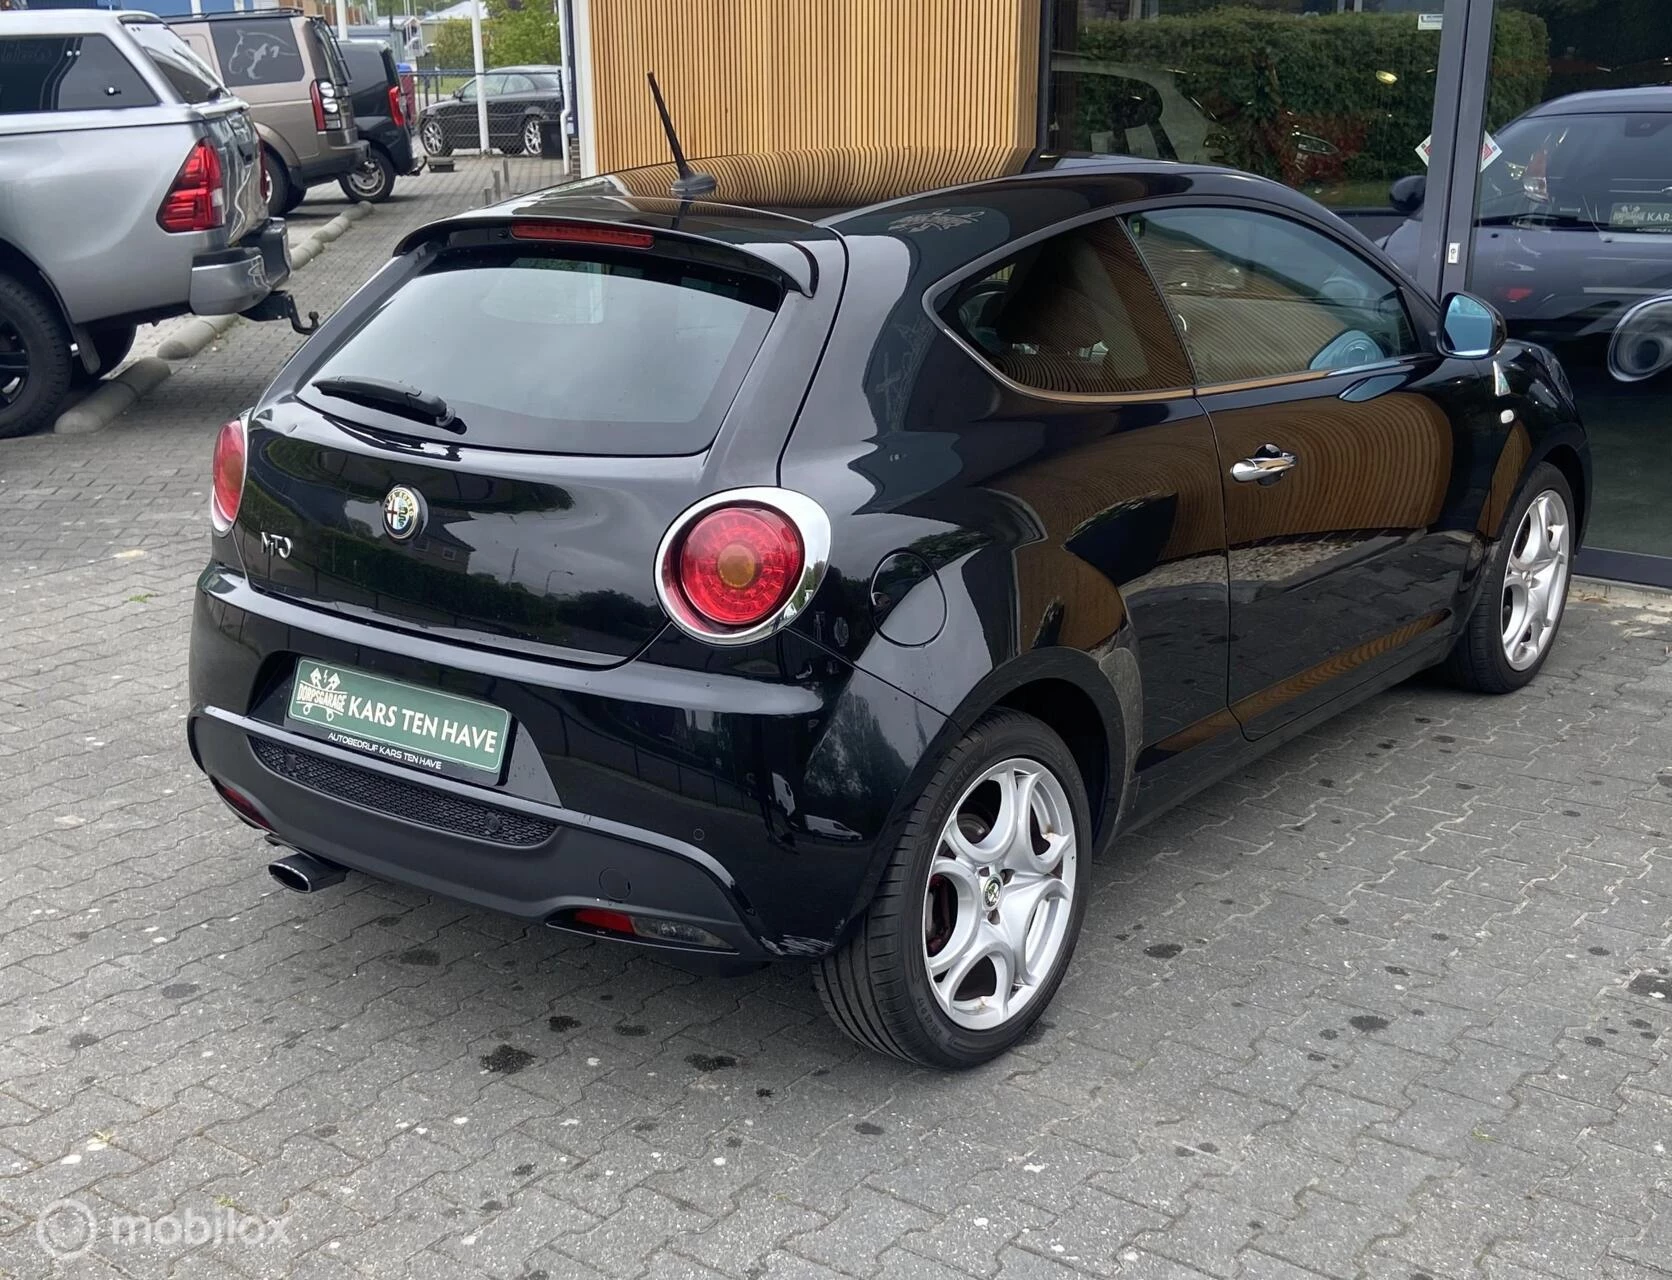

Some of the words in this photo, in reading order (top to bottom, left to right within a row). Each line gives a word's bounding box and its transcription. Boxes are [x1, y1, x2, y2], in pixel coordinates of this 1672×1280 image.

[1646, 212, 1672, 222] KAR
[297, 683, 348, 713] DORPSGARAGE
[348, 695, 398, 727] KARS
[402, 709, 438, 738] TEN
[441, 719, 498, 753] HAVE
[328, 732, 378, 751] AUTOBEDRIJF
[379, 745, 402, 759] KARS
[404, 752, 419, 762] TEN
[419, 757, 442, 770] HAVE
